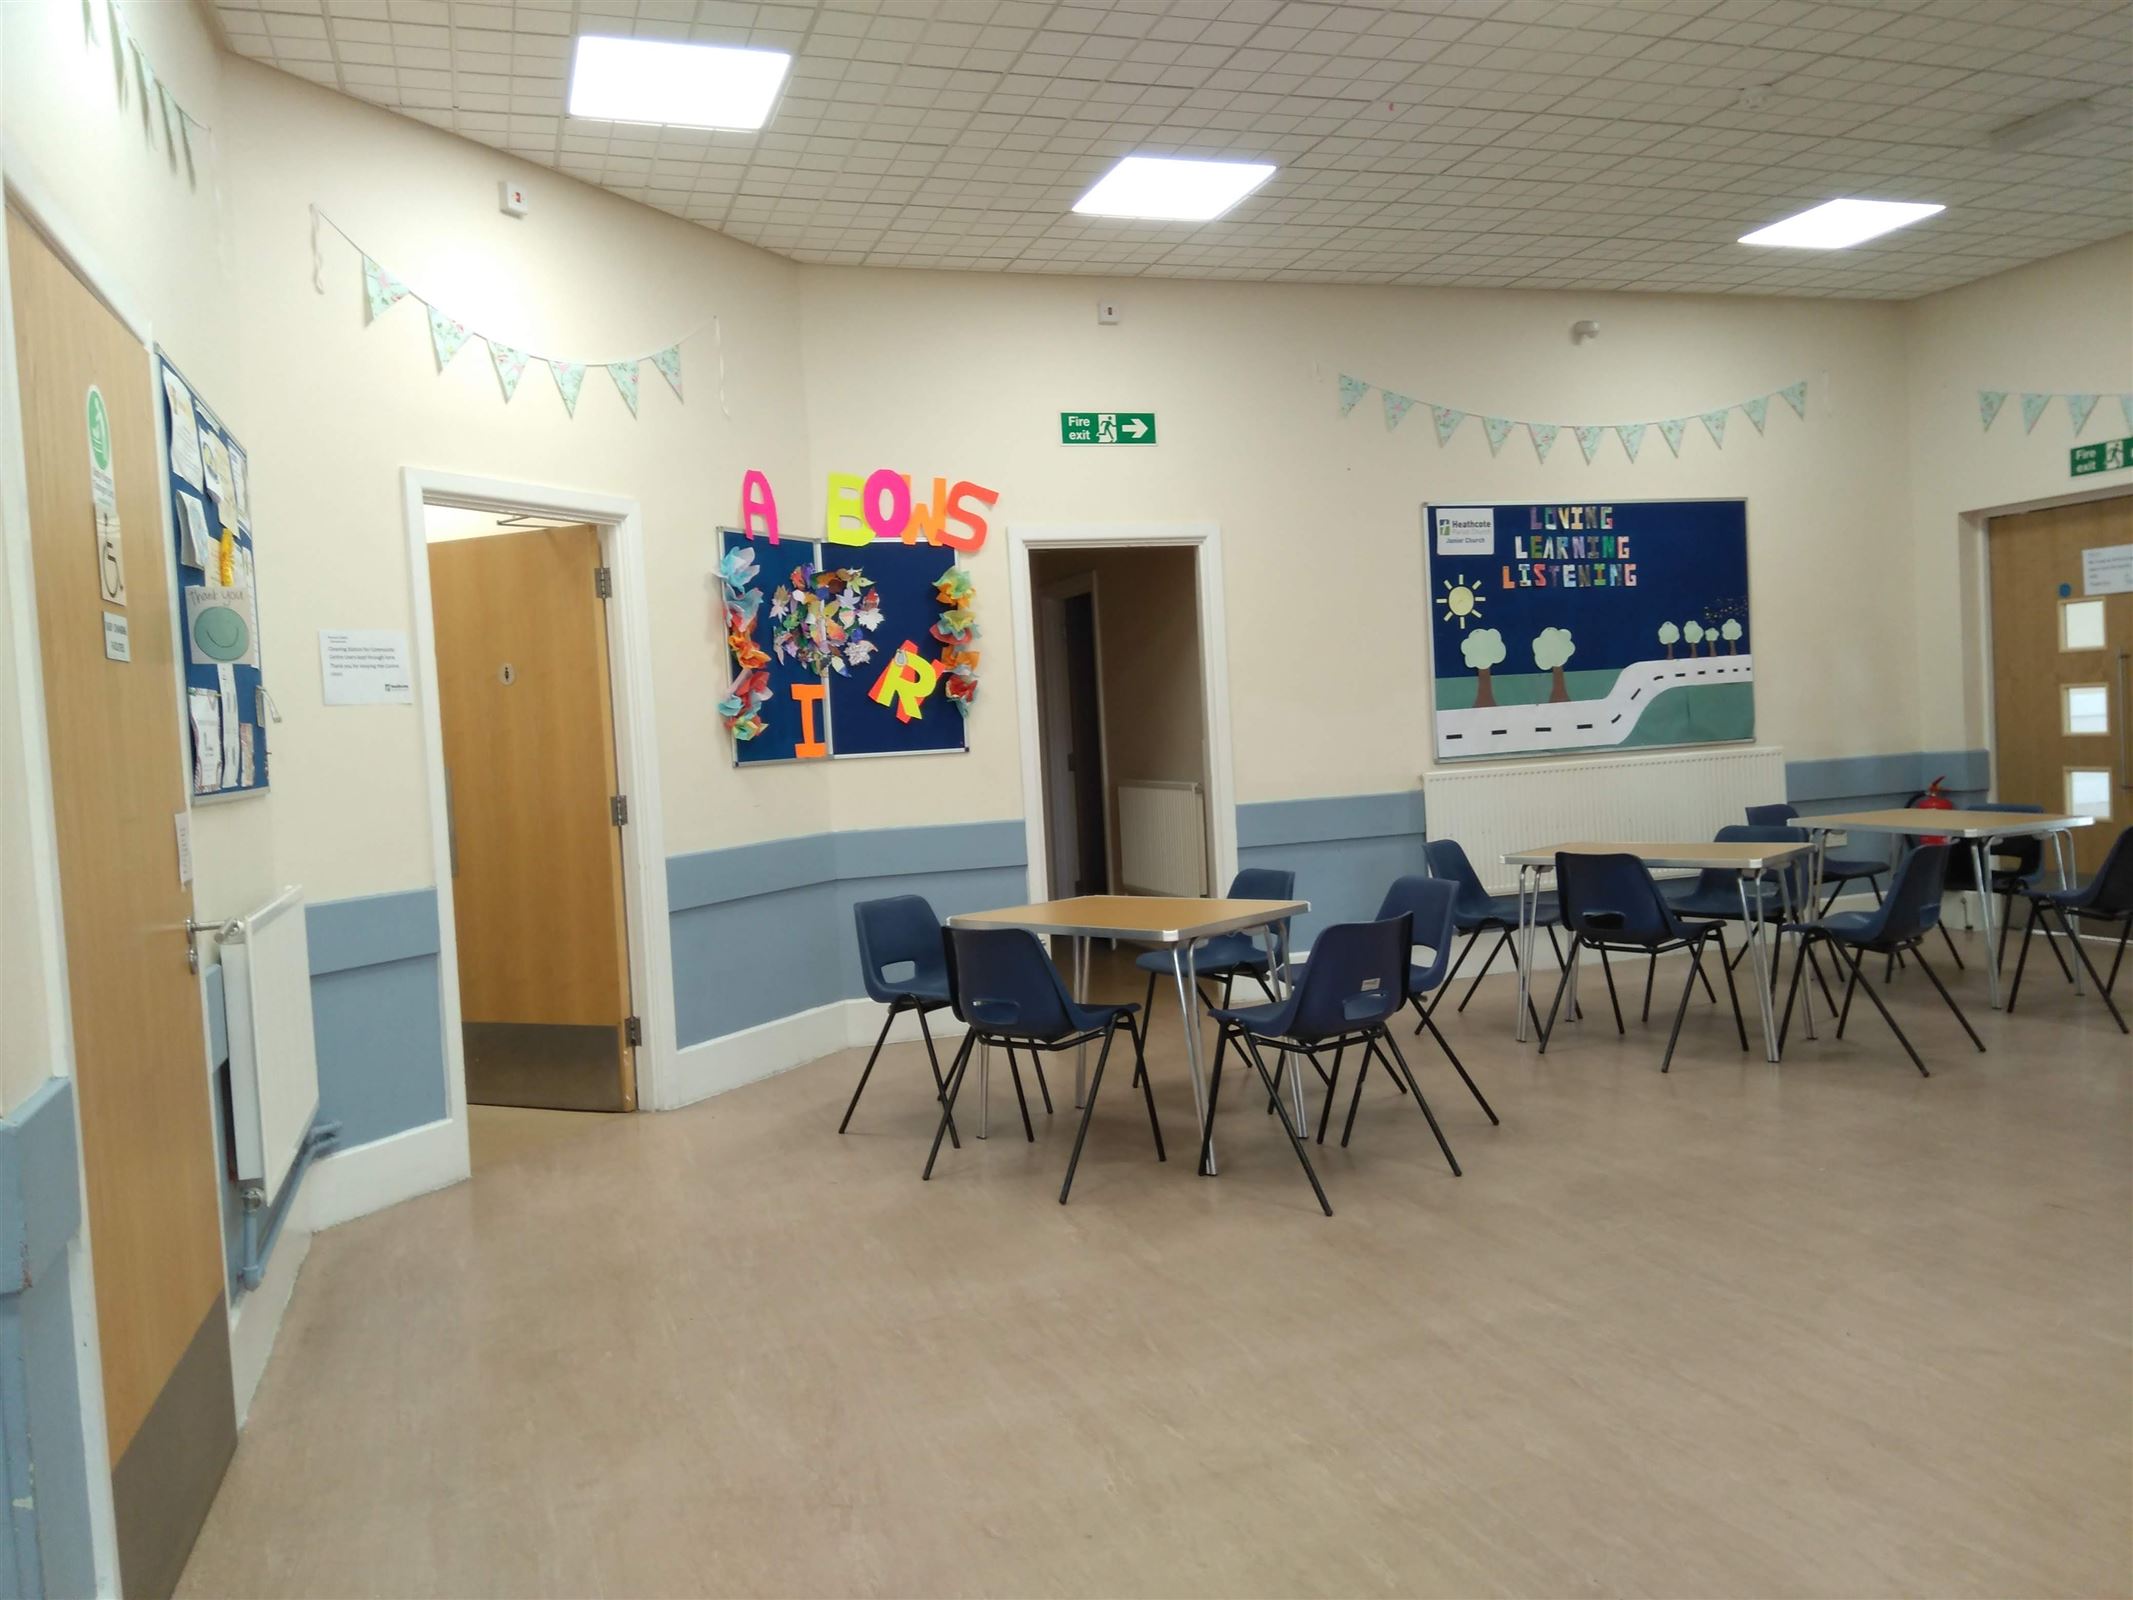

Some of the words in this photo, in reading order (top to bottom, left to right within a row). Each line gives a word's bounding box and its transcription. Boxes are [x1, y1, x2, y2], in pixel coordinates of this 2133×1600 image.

[1068, 416, 1090, 426] Fire
[1068, 430, 1091, 440] exit
[2075, 449, 2097, 460] Fire
[2076, 460, 2097, 473] exit
[1530, 506, 1613, 530] LOVING
[1452, 520, 1492, 528] Heathcote
[1465, 536, 1486, 544] Church
[1515, 536, 1630, 560] LEARNING
[1503, 563, 1638, 589] LISTENING
